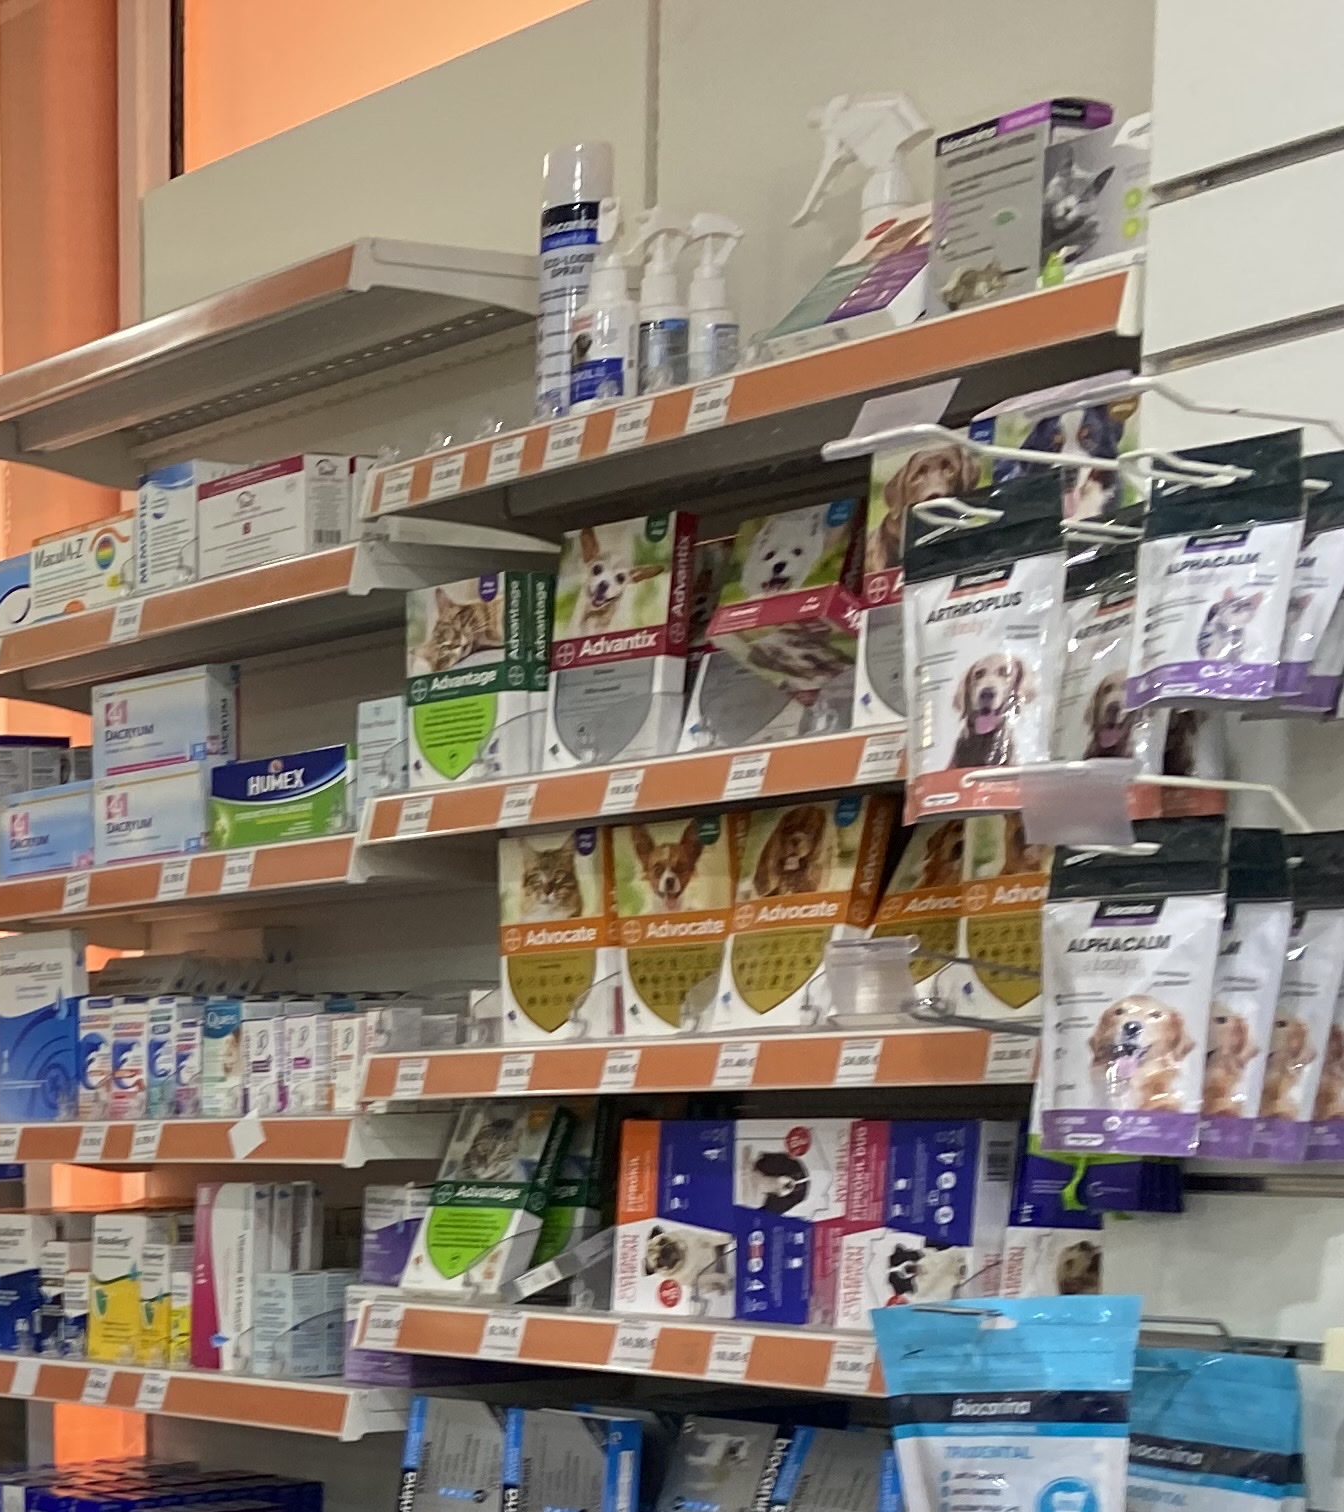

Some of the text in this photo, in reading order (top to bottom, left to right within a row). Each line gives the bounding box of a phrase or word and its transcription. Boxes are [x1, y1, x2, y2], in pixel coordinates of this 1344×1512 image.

[1165, 551, 1262, 577] ALPHACALM
[672, 534, 690, 619] Advantix
[926, 590, 1023, 626] ARTHROPLUS
[508, 579, 520, 663] Advantage
[534, 579, 546, 662] Advantage
[579, 632, 657, 657] Advantix
[431, 667, 498, 692] Advantage
[105, 723, 154, 742] DACRYUM
[247, 769, 305, 797] HUMEX
[106, 815, 153, 834] DACRYUM
[757, 900, 839, 924] Advocate
[522, 925, 597, 947] Advocate
[645, 915, 727, 939] Advocate
[1065, 933, 1172, 955] ALPHACALM
[455, 1183, 521, 1202] Advantage
[951, 1398, 1032, 1417] biocanina
